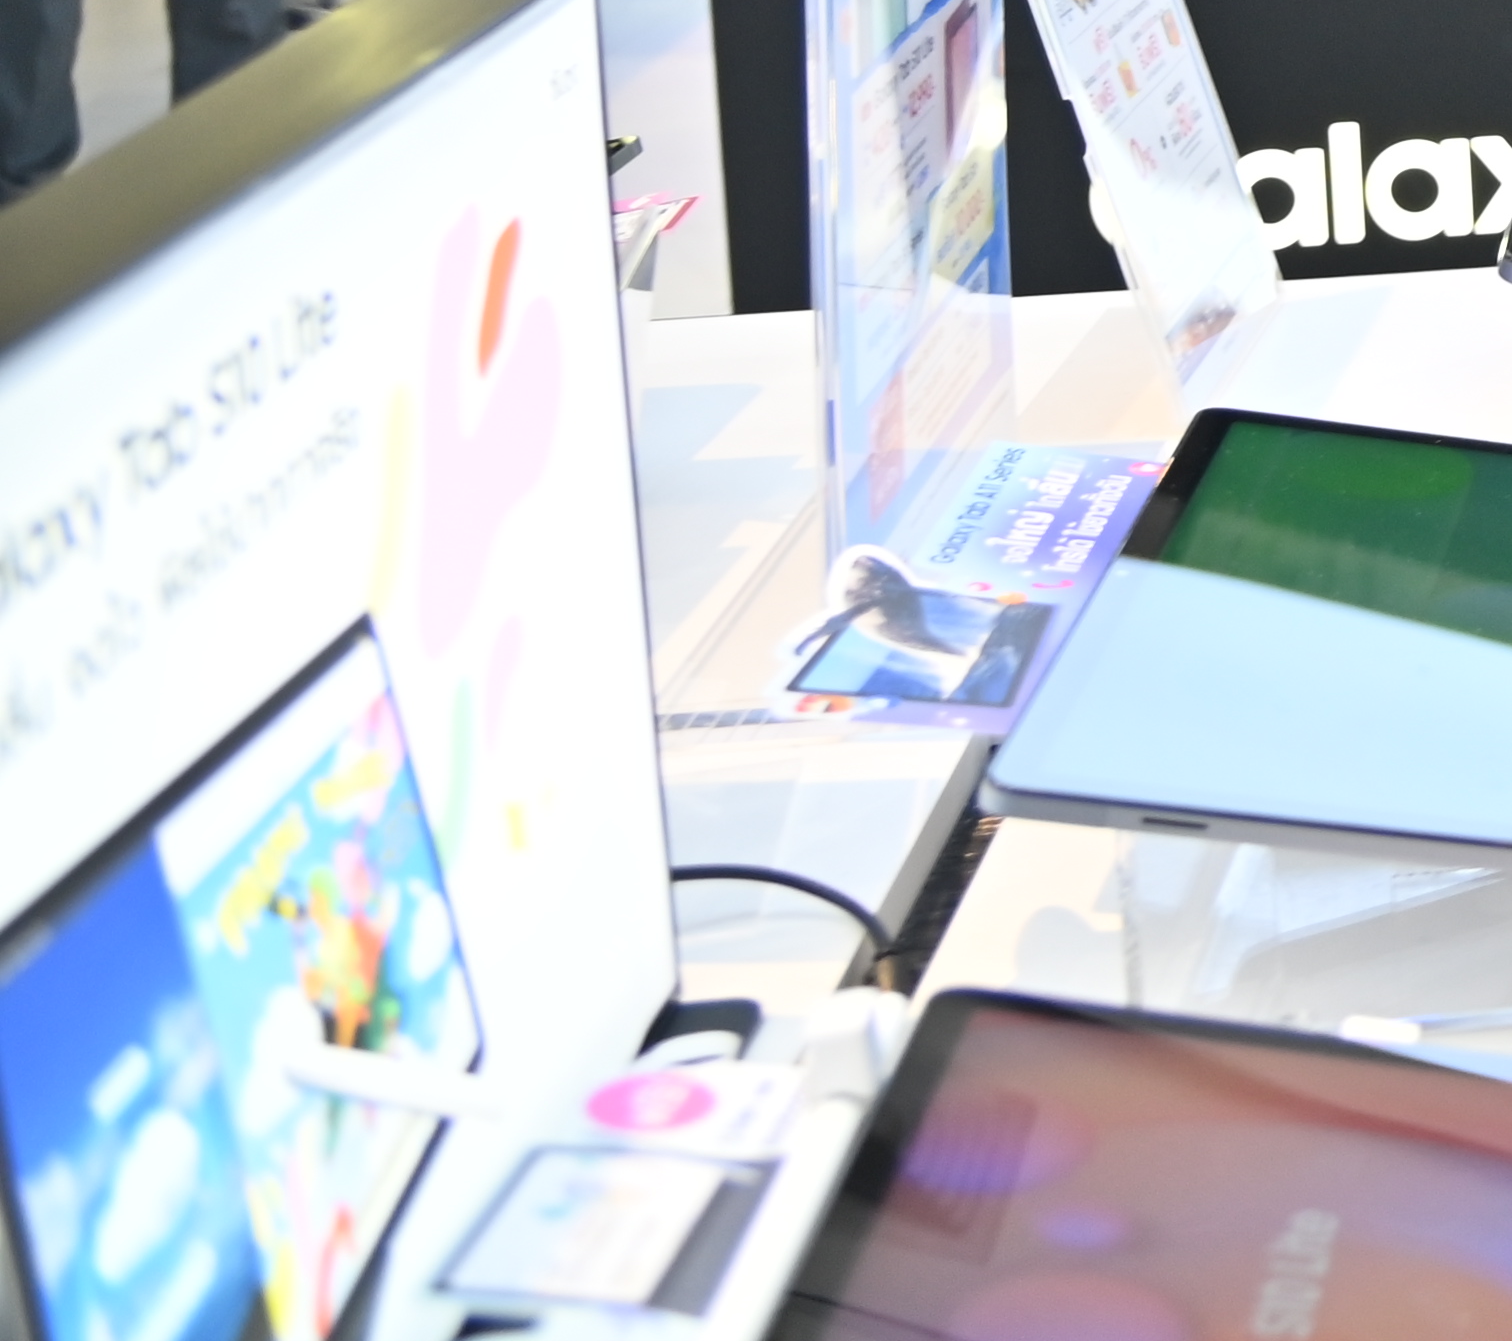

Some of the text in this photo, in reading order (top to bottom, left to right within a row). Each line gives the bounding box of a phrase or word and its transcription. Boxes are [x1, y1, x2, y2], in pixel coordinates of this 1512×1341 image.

[930, 523, 983, 565] Galaxy
[957, 500, 991, 522] Tab
[984, 446, 1028, 483] Series
